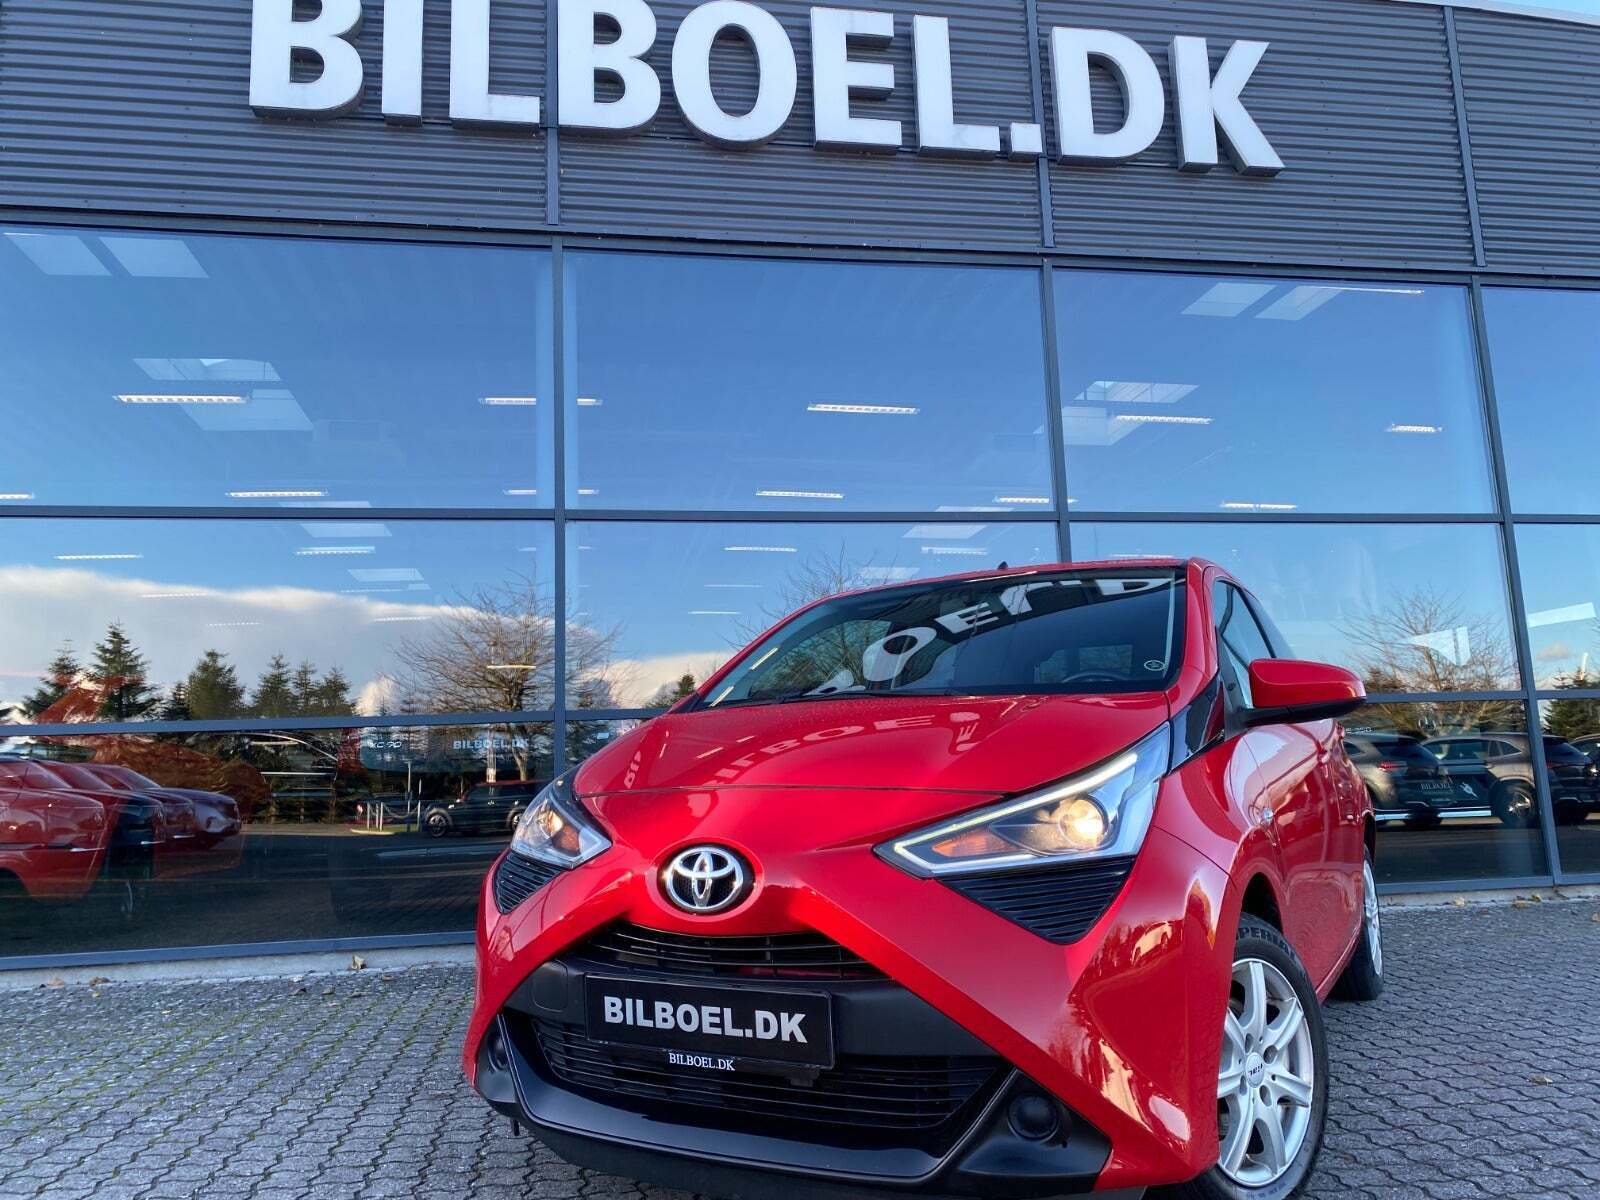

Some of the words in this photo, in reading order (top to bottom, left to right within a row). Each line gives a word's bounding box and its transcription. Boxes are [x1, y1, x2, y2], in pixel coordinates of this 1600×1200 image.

[248, 0, 1284, 175] BILBOEL.DK
[604, 996, 808, 1044] BILBOEL.DK
[668, 1052, 736, 1072] BILBOEL.DK
